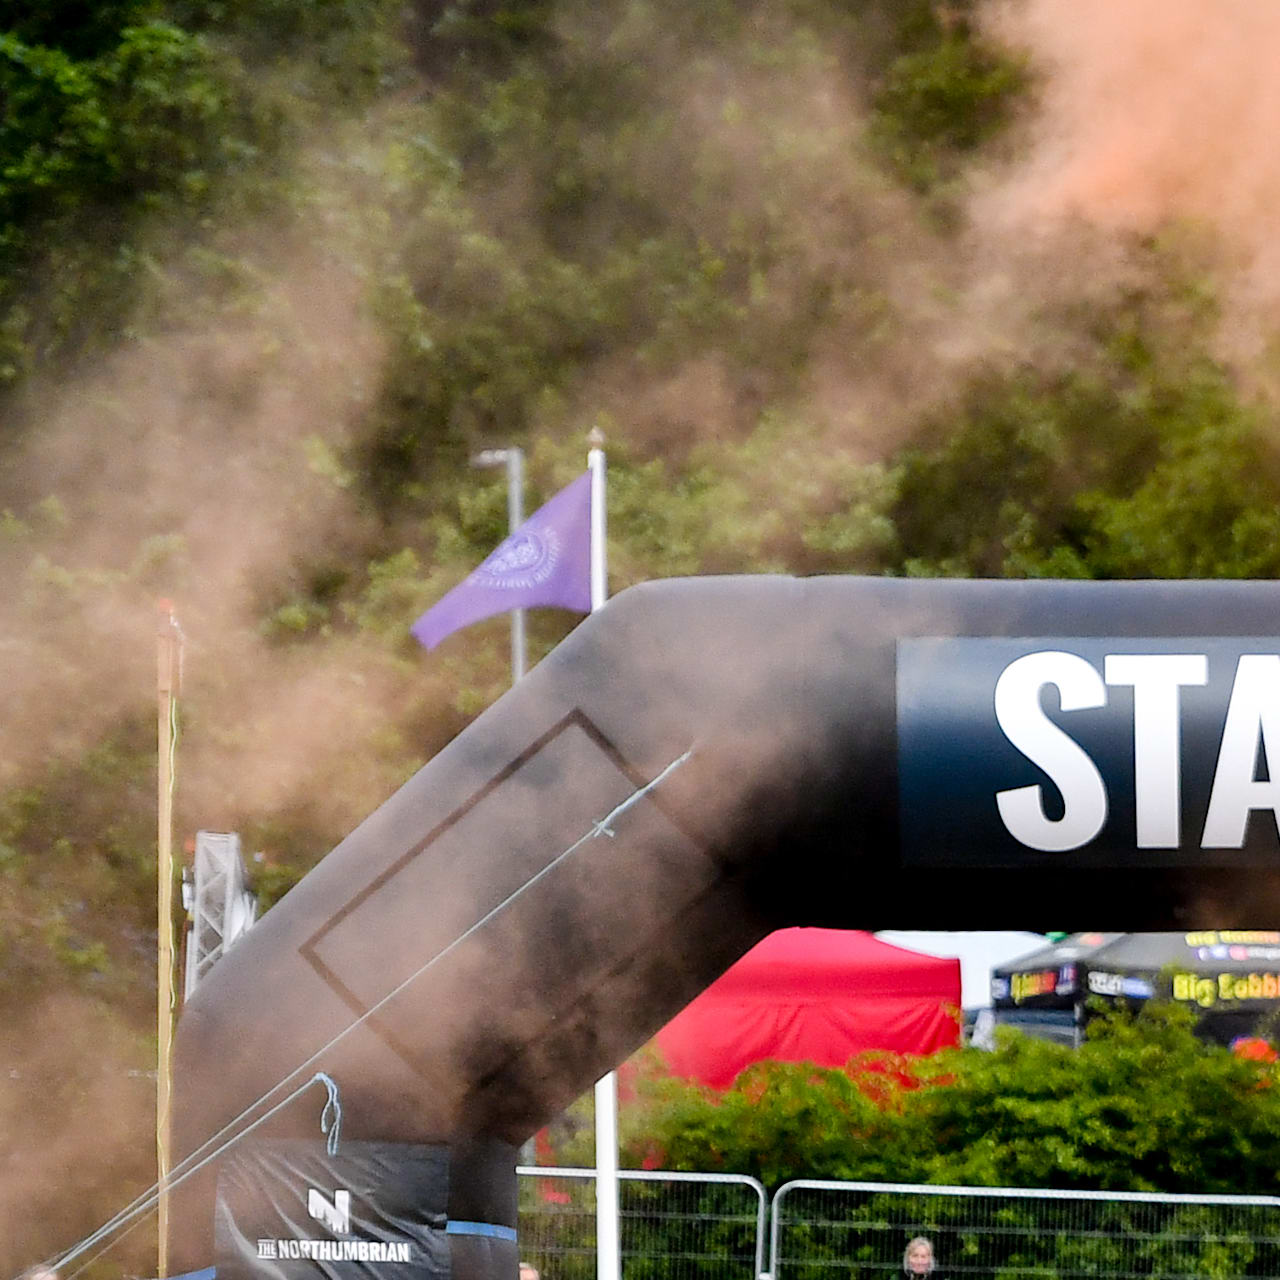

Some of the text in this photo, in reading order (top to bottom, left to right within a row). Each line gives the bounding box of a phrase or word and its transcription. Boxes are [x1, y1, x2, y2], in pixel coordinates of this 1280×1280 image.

[1173, 973, 1215, 1007] Big
[257, 1239, 410, 1262] THE NORTHUMBRIAN
